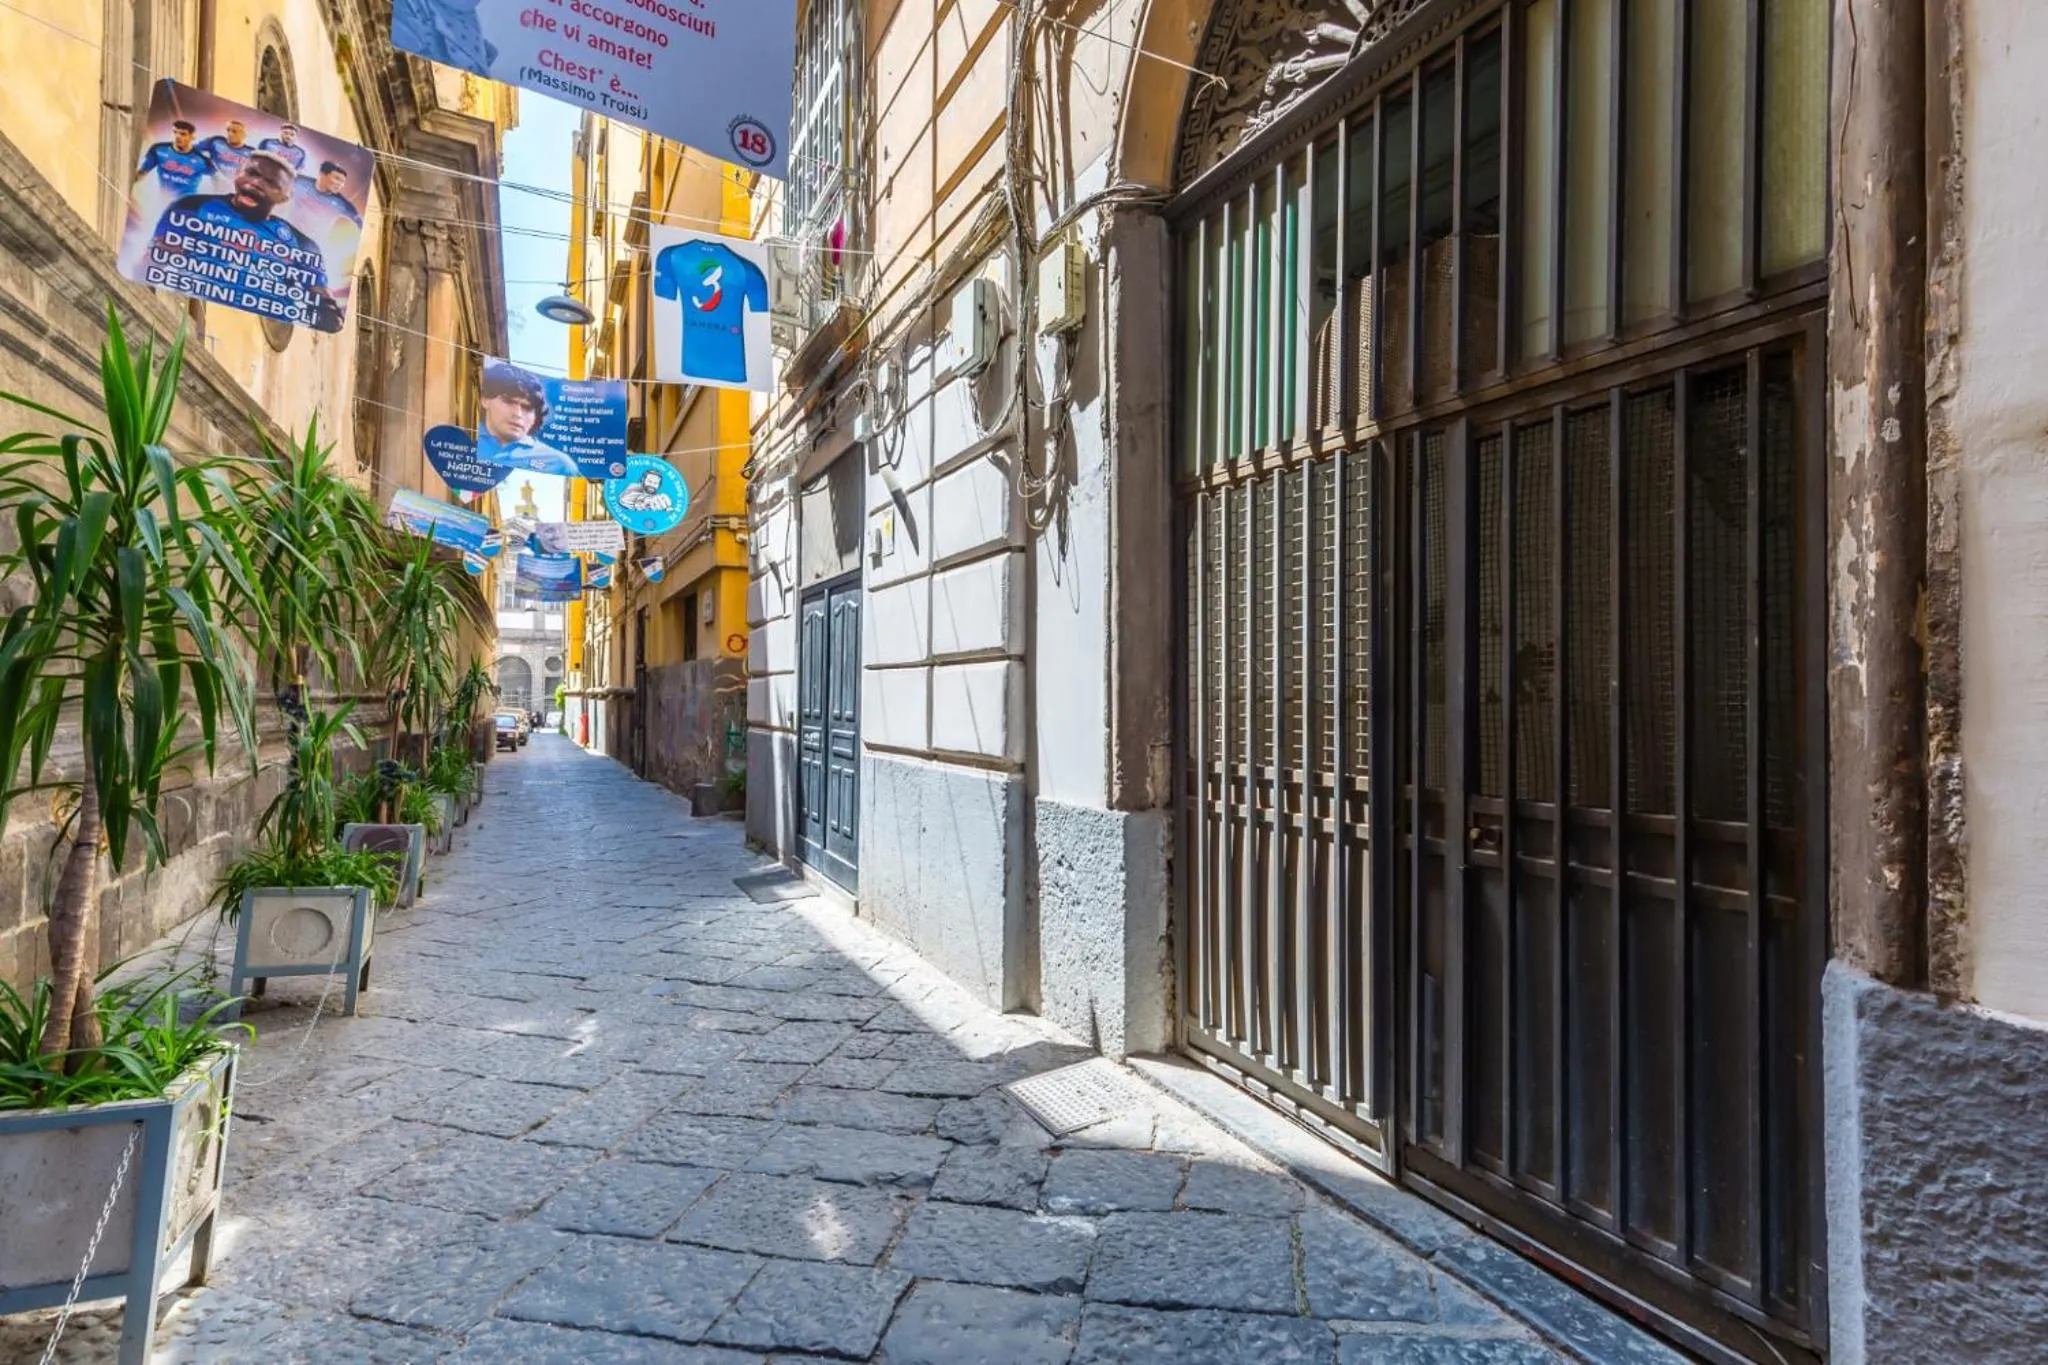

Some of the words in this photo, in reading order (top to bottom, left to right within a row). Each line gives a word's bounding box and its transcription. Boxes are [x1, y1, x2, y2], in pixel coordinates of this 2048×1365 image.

[519, 8, 557, 33] che
[564, 24, 580, 42] vi
[587, 34, 653, 69] amate!
[519, 66, 596, 101] (Massimo
[600, 92, 648, 120] Troisi)
[538, 49, 604, 83] Chest'
[609, 74, 639, 100] è...
[738, 128, 767, 155] 18
[165, 231, 250, 267] DESTINI
[257, 258, 316, 286] FORTI
[169, 211, 255, 248] UOMINI
[261, 239, 321, 268] FORTI
[147, 267, 235, 303] DESTINI
[241, 294, 318, 325] DEBOLI
[152, 248, 239, 284] UOMINI
[245, 275, 321, 307] DEBOLI
[447, 460, 493, 477] NAPOLI
